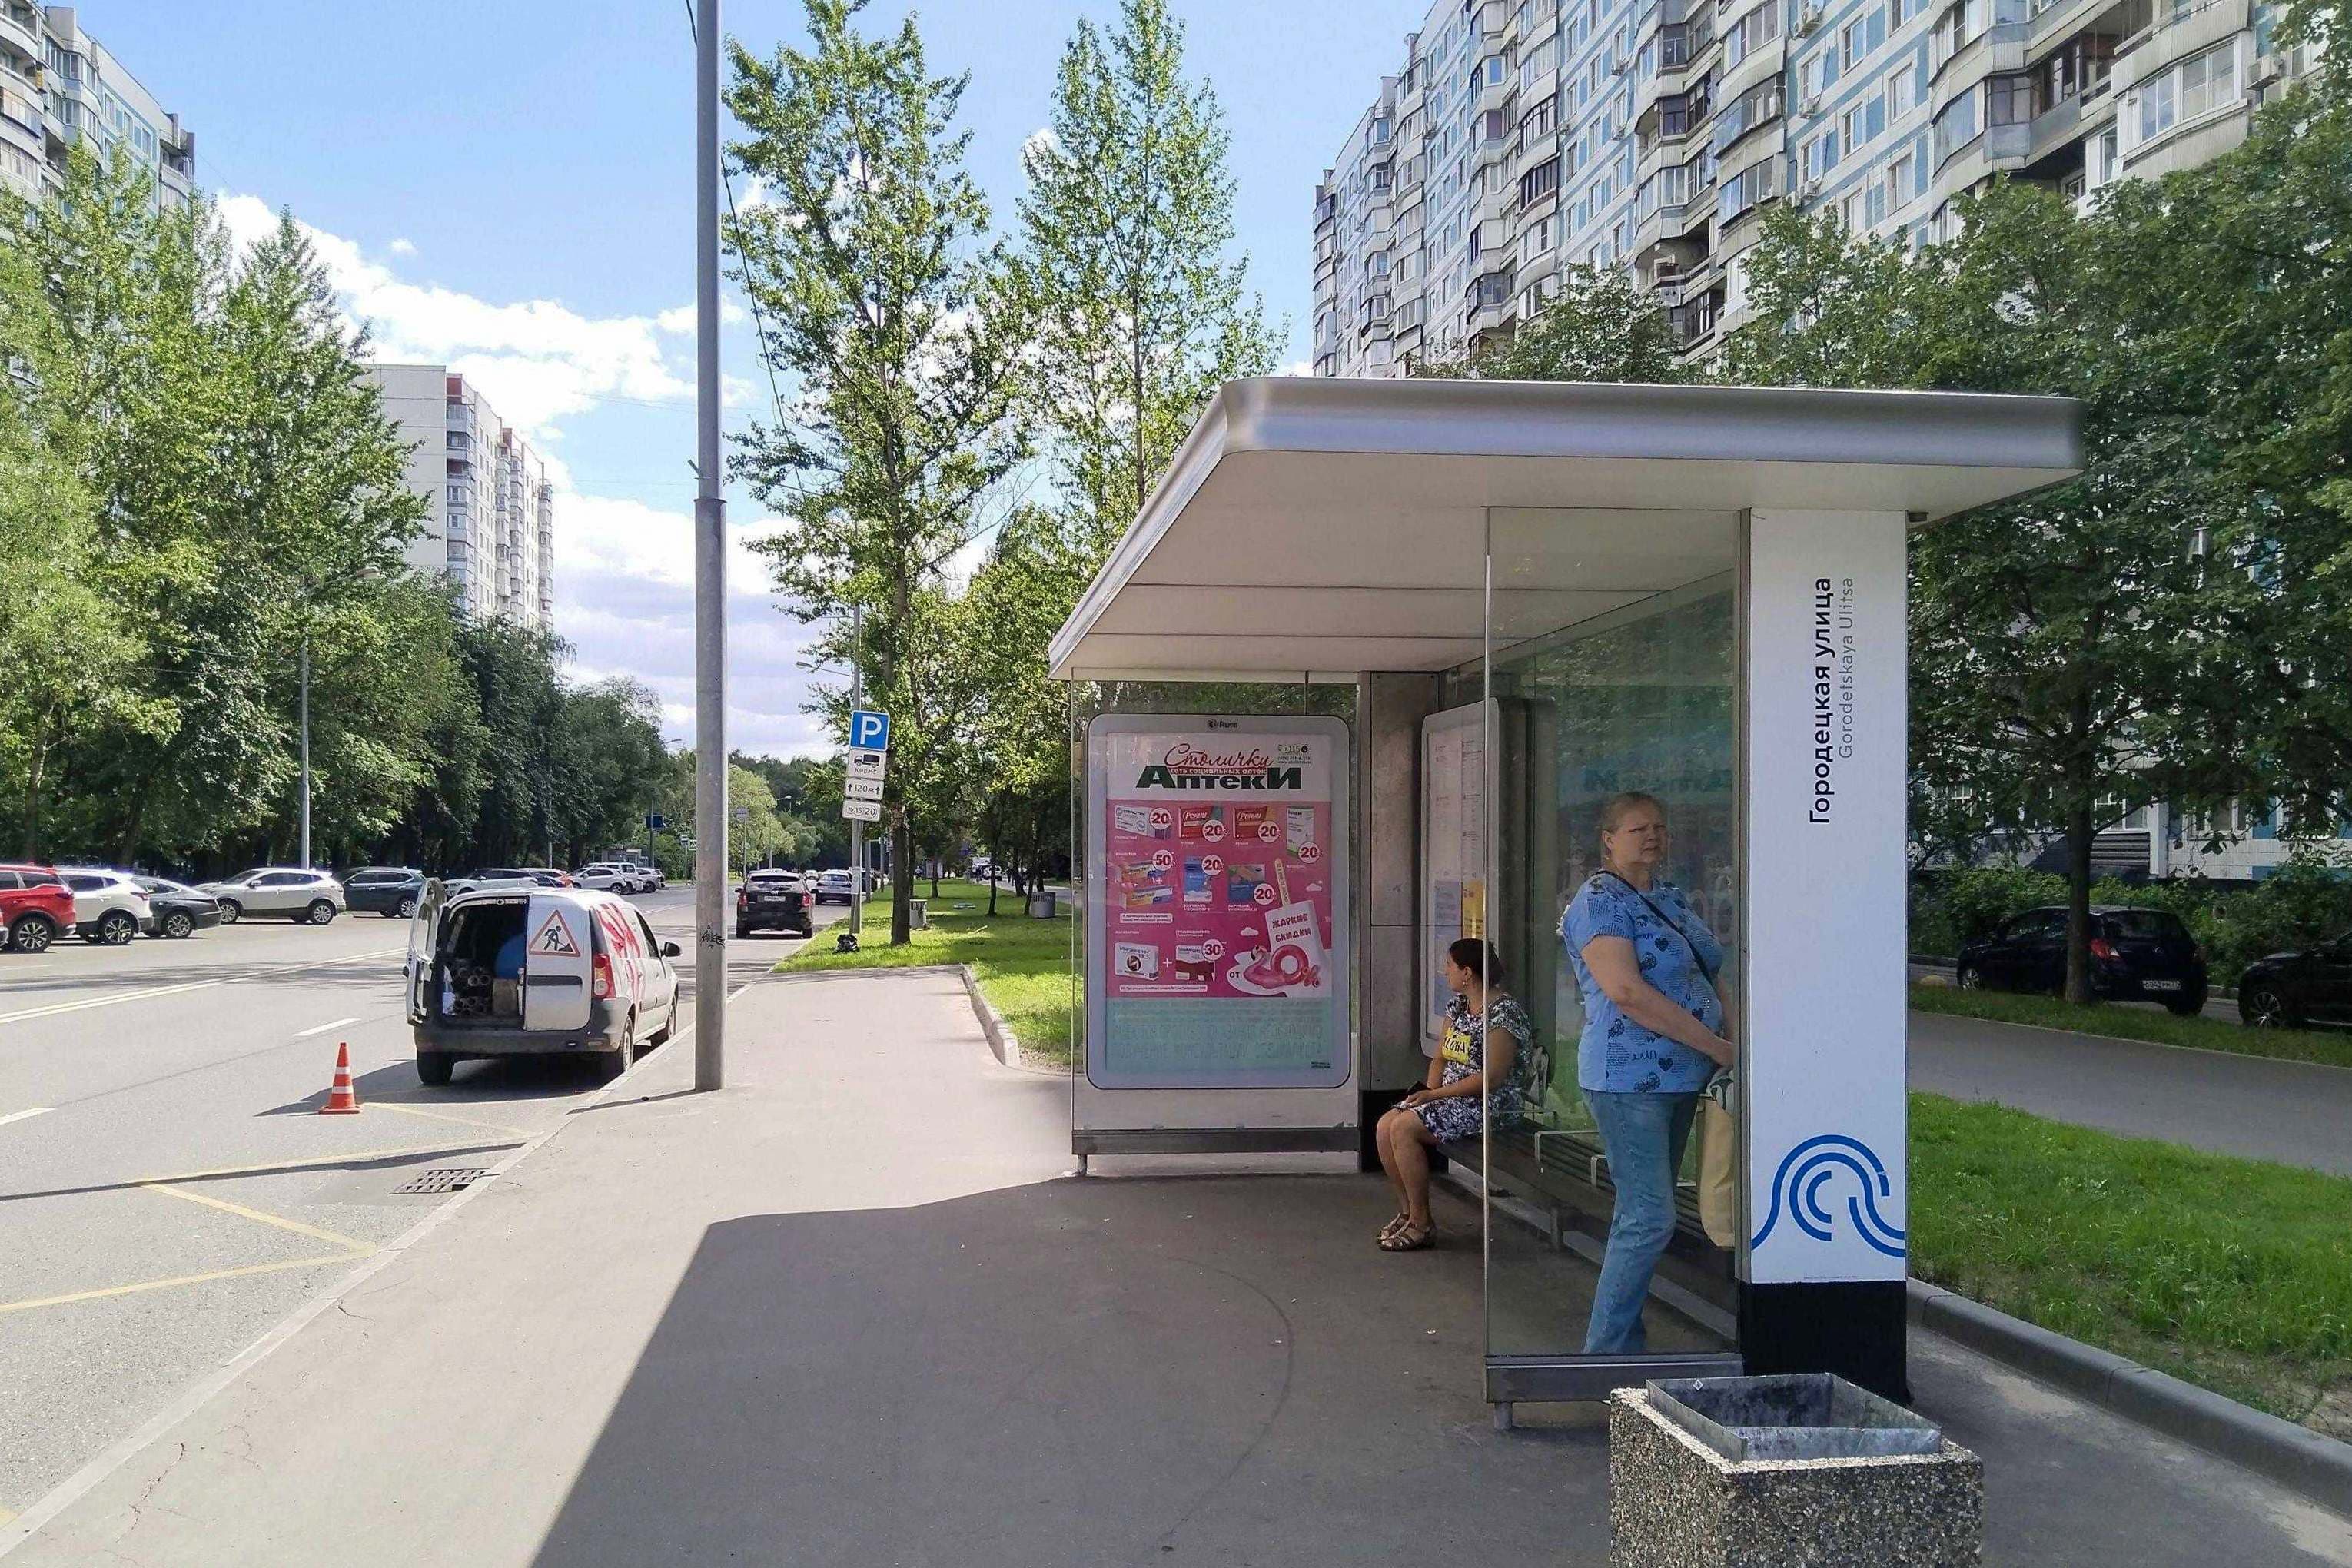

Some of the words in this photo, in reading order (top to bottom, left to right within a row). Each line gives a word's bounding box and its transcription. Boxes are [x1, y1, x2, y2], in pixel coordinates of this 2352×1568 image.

[1815, 576, 1835, 658] улица
[1838, 576, 1853, 630] Ulitsa
[1809, 666, 1835, 824] Городецкая
[1838, 635, 1857, 759] Gorodetskaya
